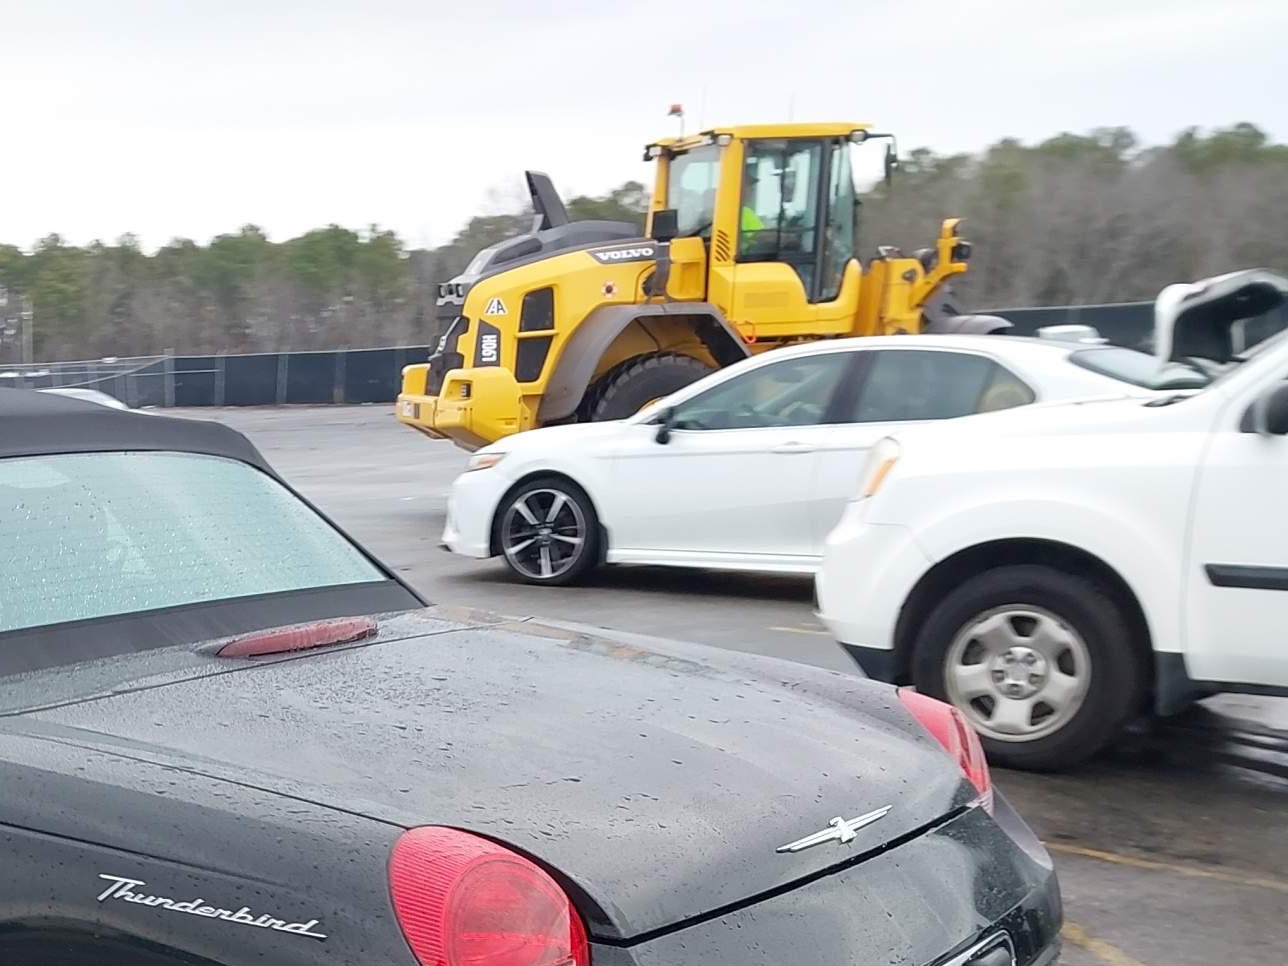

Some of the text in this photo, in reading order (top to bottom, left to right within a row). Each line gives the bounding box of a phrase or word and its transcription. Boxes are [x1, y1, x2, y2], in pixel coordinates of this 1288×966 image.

[596, 248, 653, 260] VOLVO
[482, 335, 497, 362] L90H
[98, 874, 327, 938] Thunderbird
